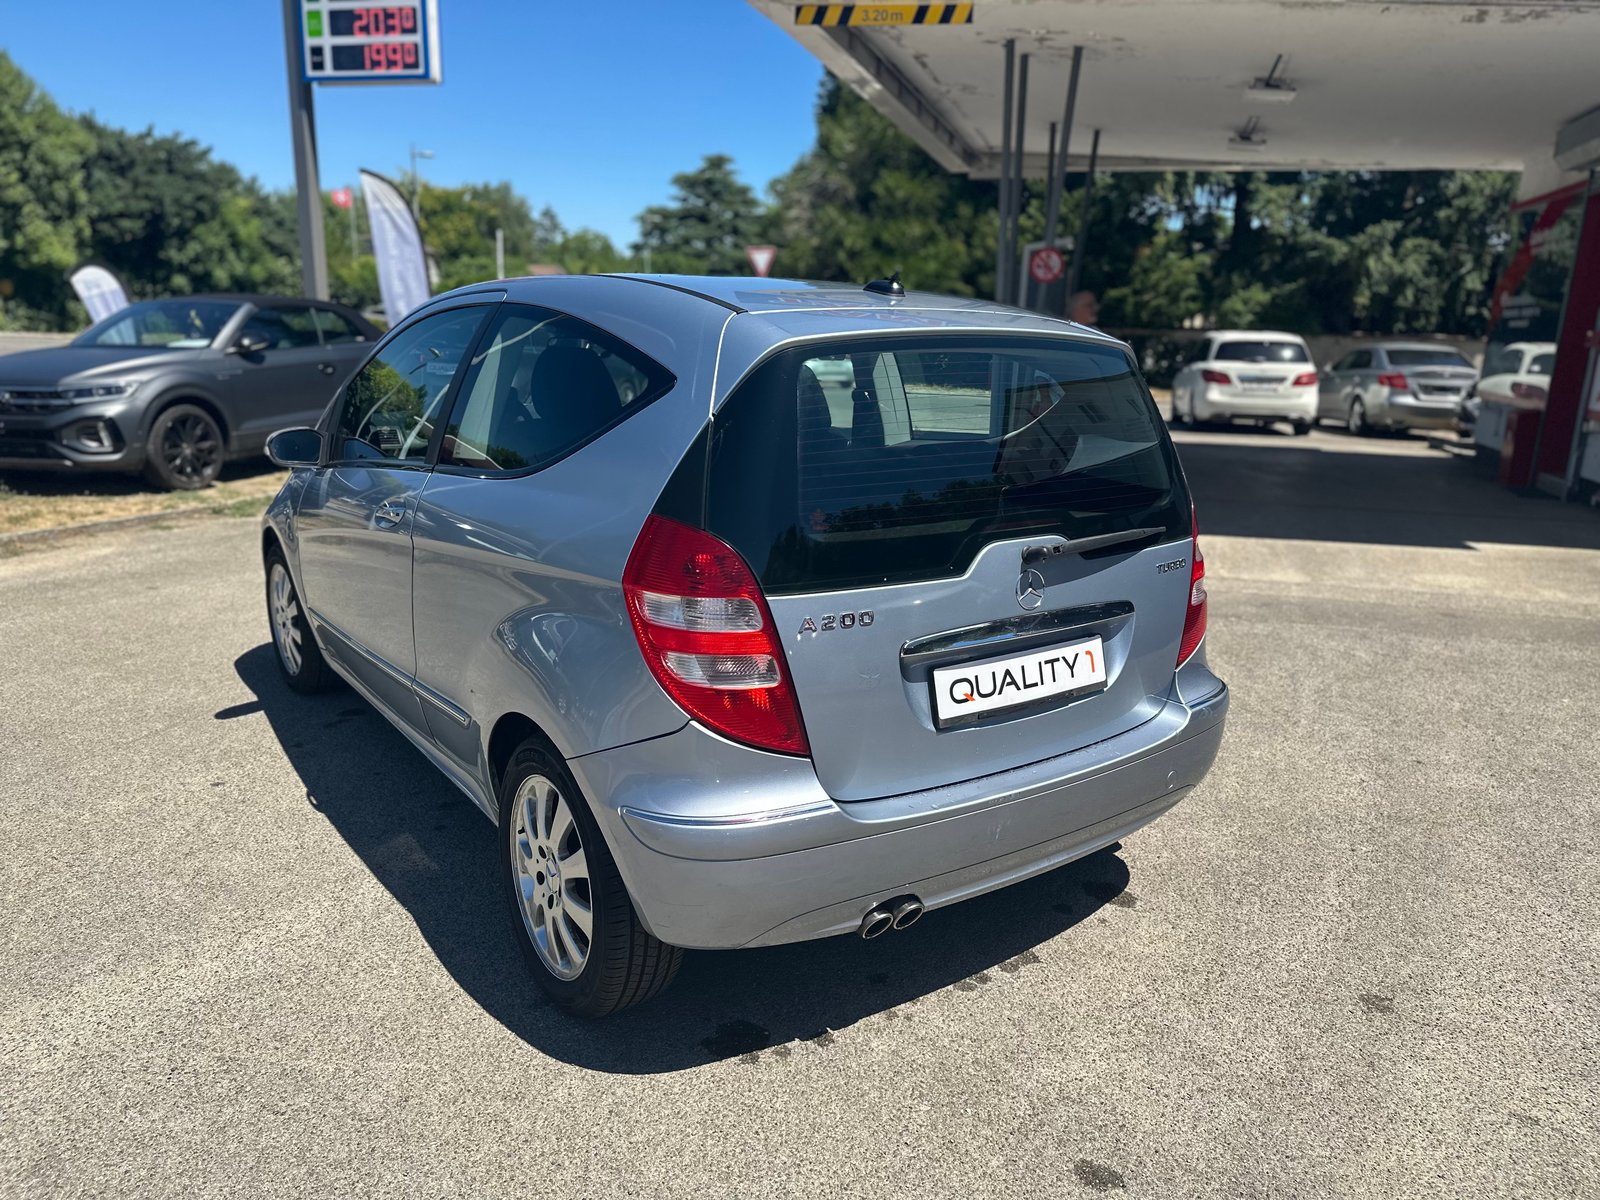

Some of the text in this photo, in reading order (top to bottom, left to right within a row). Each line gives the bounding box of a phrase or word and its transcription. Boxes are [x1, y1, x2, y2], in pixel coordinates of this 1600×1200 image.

[861, 9, 889, 22] 3.20
[1156, 558, 1187, 574] TURBO
[949, 652, 1080, 705] QUALITY
